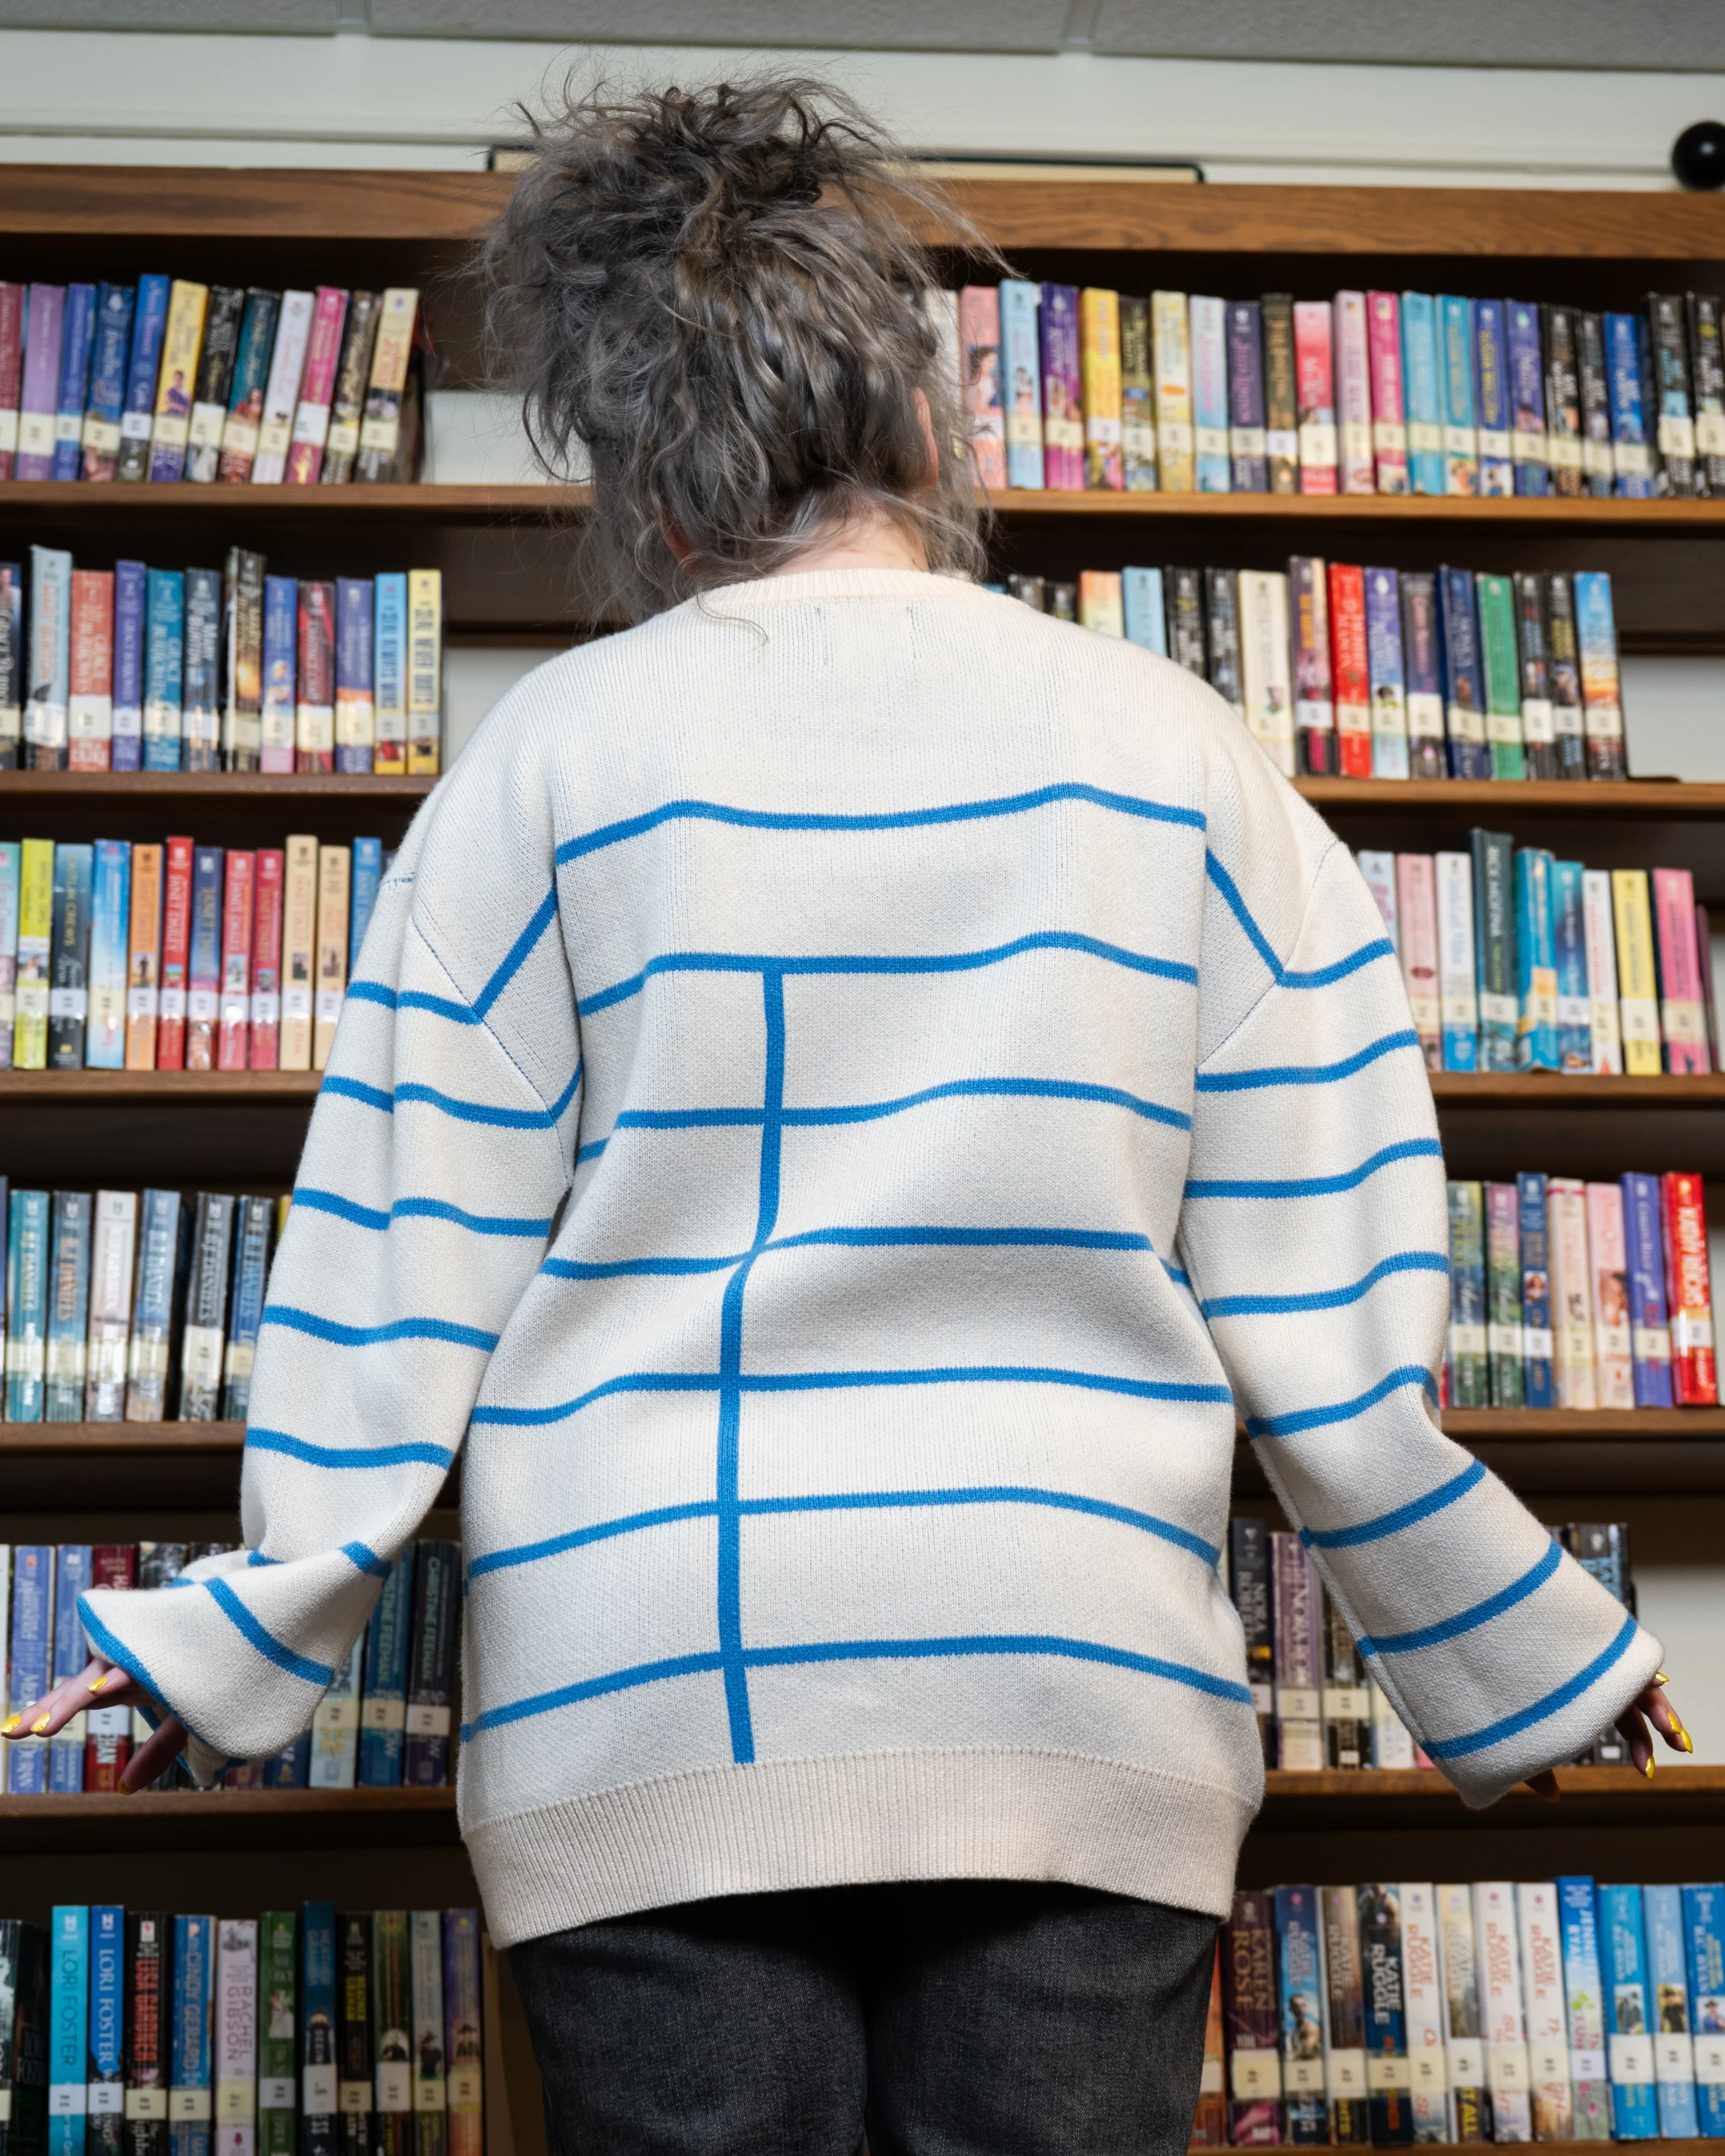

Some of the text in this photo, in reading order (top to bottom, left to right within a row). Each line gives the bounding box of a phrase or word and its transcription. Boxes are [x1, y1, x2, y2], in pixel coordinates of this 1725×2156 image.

[1486, 846, 1503, 937] RICK MOFINA
[421, 1557, 441, 1680] CHRISTINE FEEHAN
[1232, 1931, 1251, 2010] ROSE
[1252, 1929, 1272, 2011] KAREN
[1371, 1944, 1389, 2025] RUGGLE
[1387, 1956, 1401, 2011] KATIE
[1406, 1923, 1423, 1999] RUGGLE
[1420, 1936, 1434, 1987] KATIE
[1486, 1922, 1502, 1997] RUGGLE
[1499, 1934, 1513, 1985] KATIE
[1530, 1924, 1546, 2001] RUGGLE
[1544, 1937, 1557, 1987] KATIE
[61, 1950, 77, 2066] LORI FOSTER
[98, 1949, 115, 2065] LORI FOSTER
[133, 1959, 159, 2061] LISA GARDNER
[182, 1950, 202, 2069] CINDY GERARD
[226, 1985, 239, 2061] GIBSON
[239, 1985, 253, 2060] RACHEL
[314, 2029, 322, 2065] SEEIN
[1463, 2103, 1477, 2135] ALL
